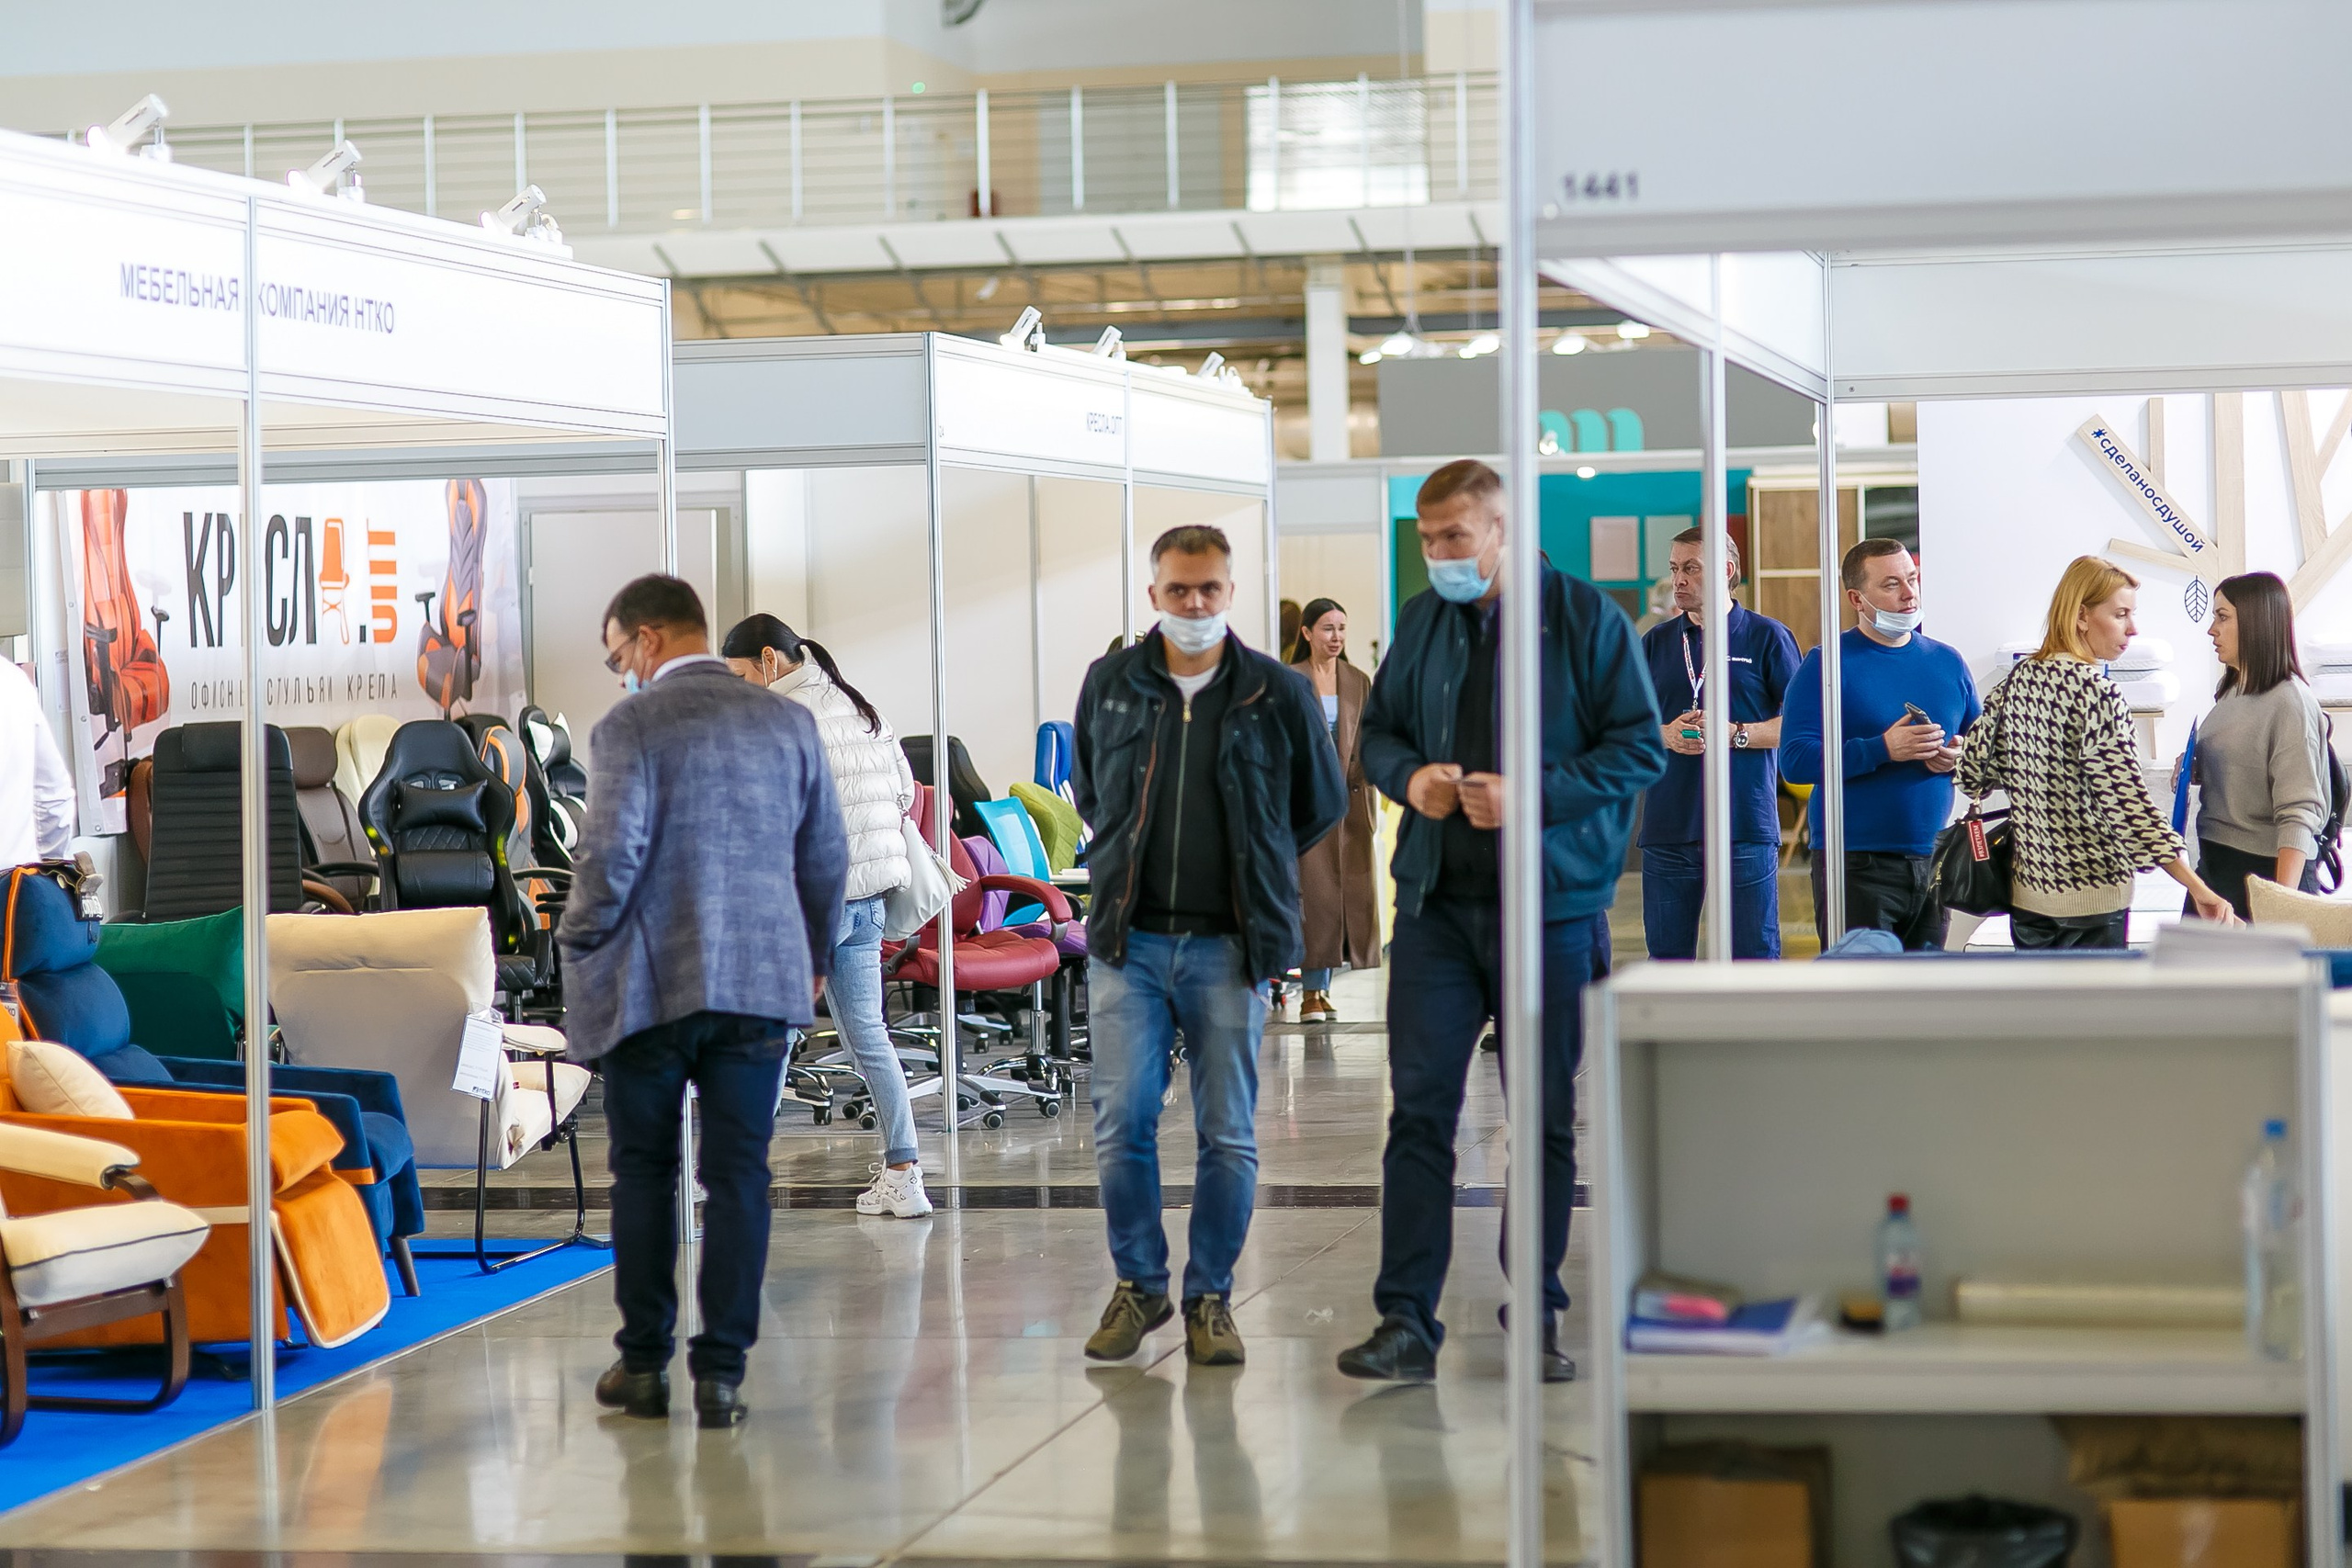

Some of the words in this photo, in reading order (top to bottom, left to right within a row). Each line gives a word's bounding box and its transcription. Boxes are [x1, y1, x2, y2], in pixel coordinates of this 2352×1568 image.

[1563, 171, 1640, 201] 1441
[120, 262, 240, 311] МЕБЕЛЬНАЯ
[355, 297, 395, 334] НТКО
[2091, 428, 2206, 553] #сделаносдушой
